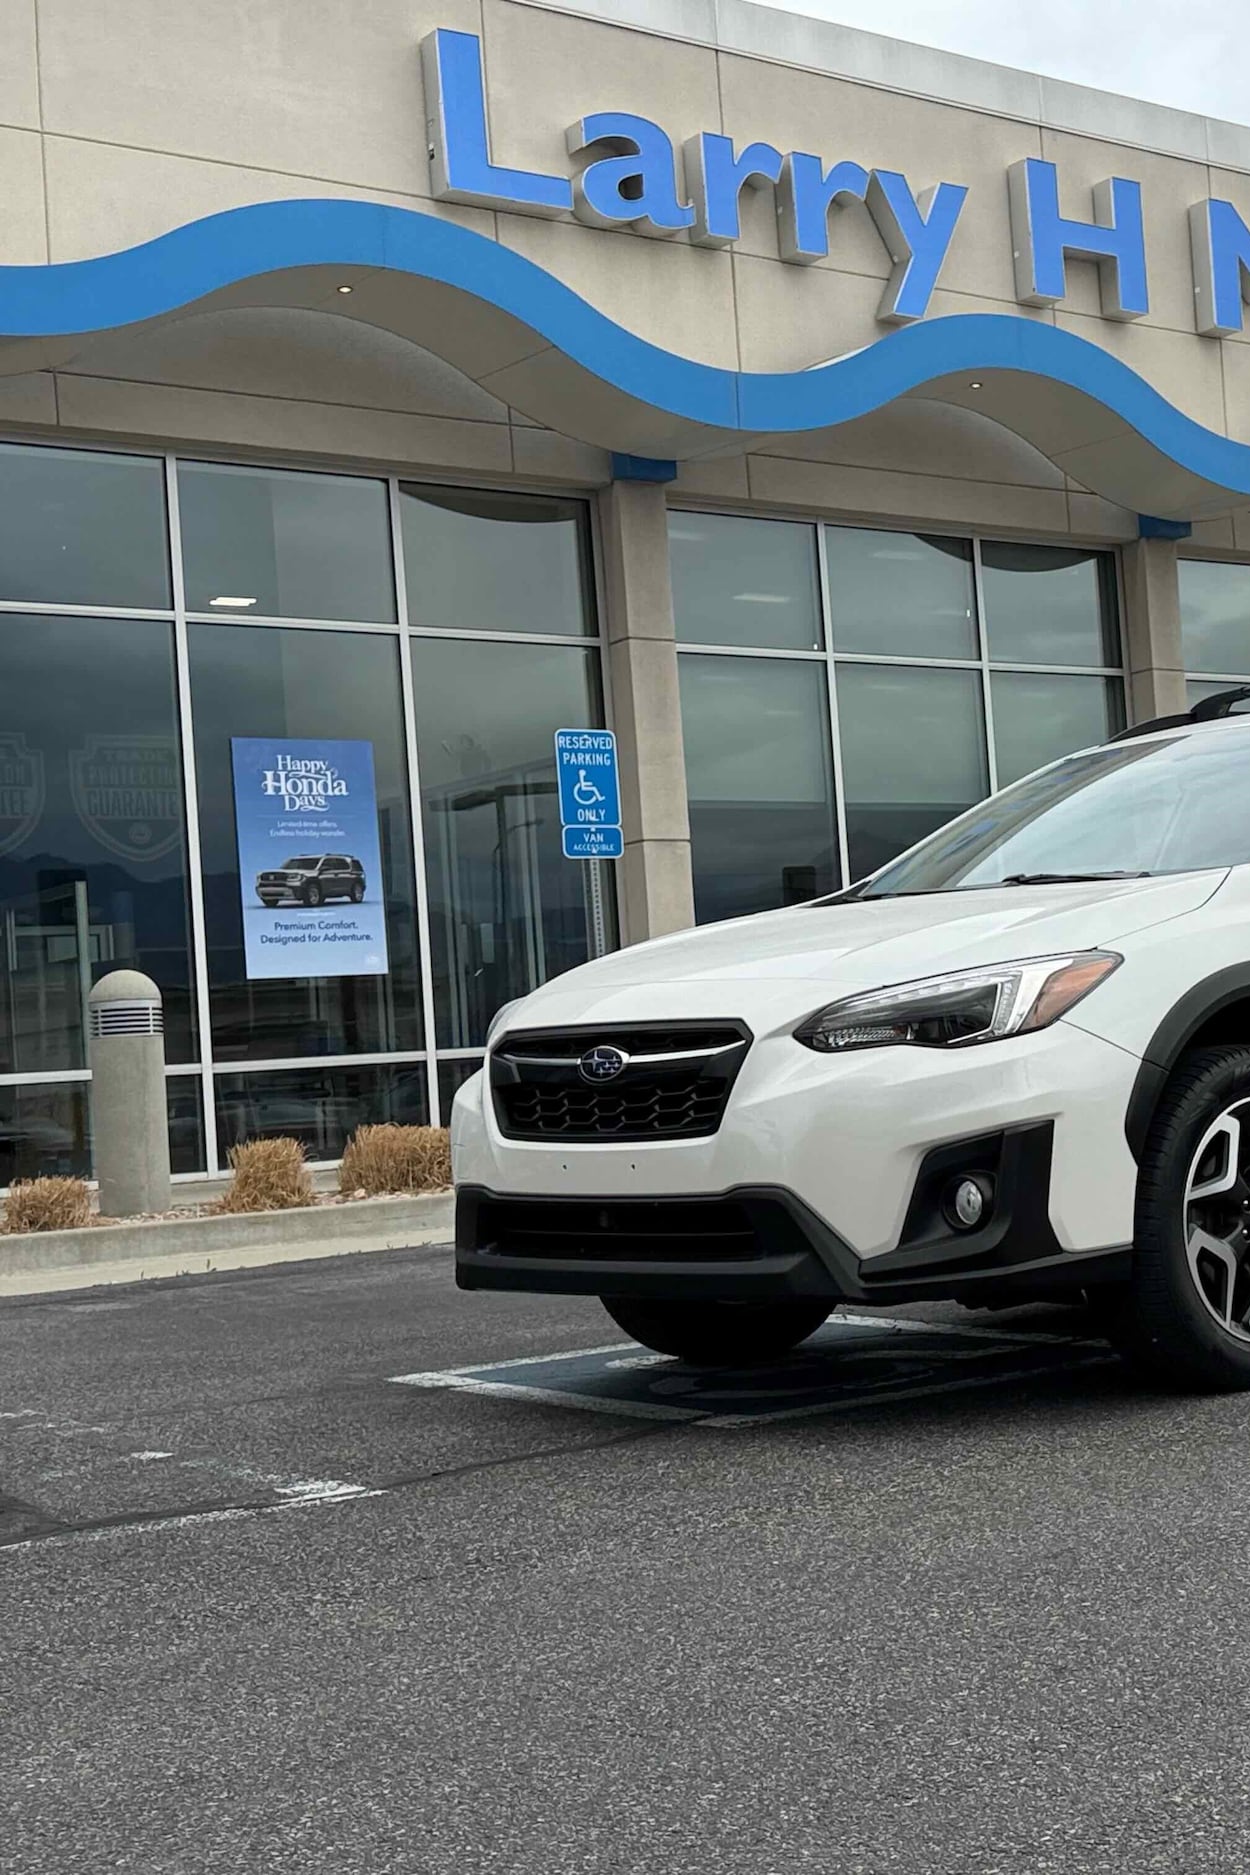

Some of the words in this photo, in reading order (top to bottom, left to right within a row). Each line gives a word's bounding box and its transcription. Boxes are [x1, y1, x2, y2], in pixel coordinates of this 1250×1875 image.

[423, 27, 969, 322] Larry
[1010, 157, 1149, 319] H
[558, 735, 613, 750] RESERVED
[276, 754, 329, 776] Happy
[563, 752, 611, 766] PARKING
[261, 770, 349, 796] Honda
[284, 795, 330, 812] Days
[577, 808, 606, 822] ONLY
[583, 832, 604, 843] VAN
[573, 843, 614, 851] ACCESSIBLE
[274, 921, 316, 931] Premium
[318, 920, 358, 931] Comfort.
[261, 934, 306, 946] Designed
[307, 932, 321, 943] for
[322, 931, 373, 943] Adventure.
